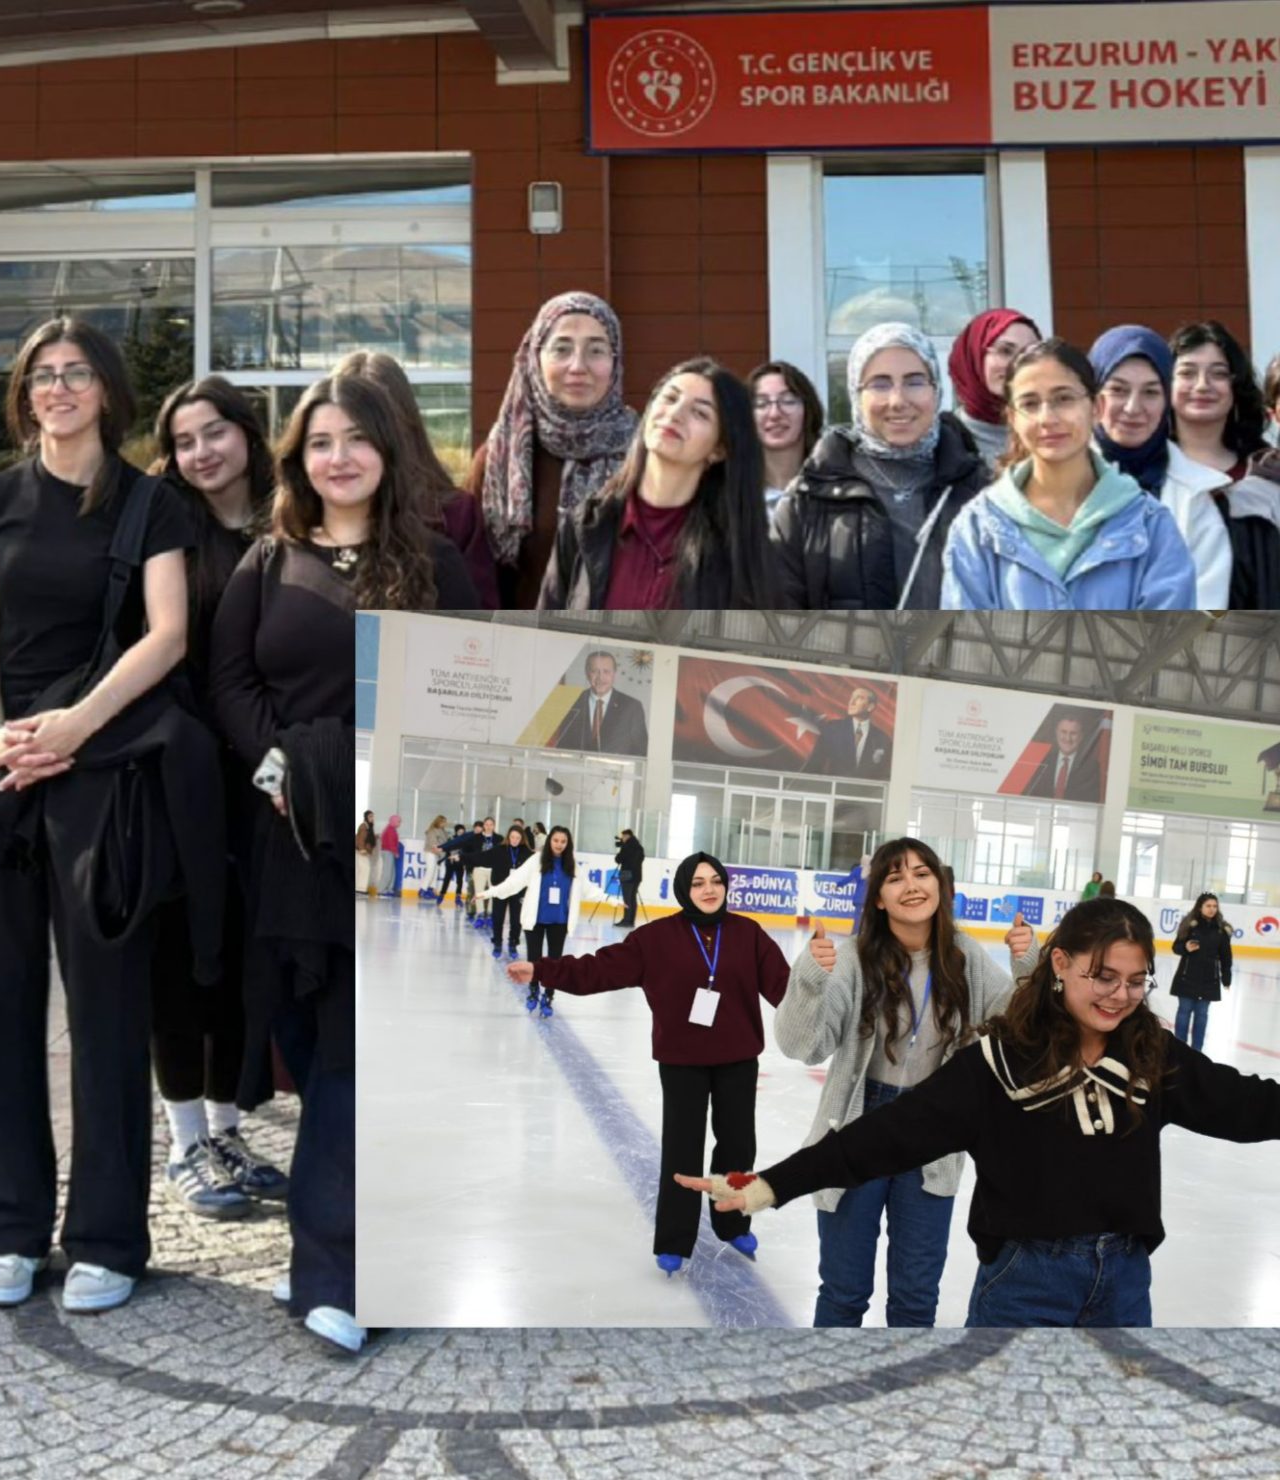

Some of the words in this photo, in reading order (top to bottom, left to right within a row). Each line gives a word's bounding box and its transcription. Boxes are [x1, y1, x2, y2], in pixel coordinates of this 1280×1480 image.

[739, 54, 782, 75] T.C.
[788, 46, 895, 77] GENÇLİK
[899, 50, 933, 71] VE
[1012, 40, 1178, 67] ERZURUM
[1206, 38, 1280, 64] YAK
[740, 85, 806, 107] SPOR
[813, 78, 949, 105] BAKANLIĞI
[1013, 79, 1097, 112] BUZ
[1109, 69, 1267, 110] HOKEYİ
[1169, 758, 1188, 770] TAM
[731, 873, 750, 888] 25.
[752, 873, 793, 890] DÜNYA
[745, 892, 799, 907] OYUNLAR
